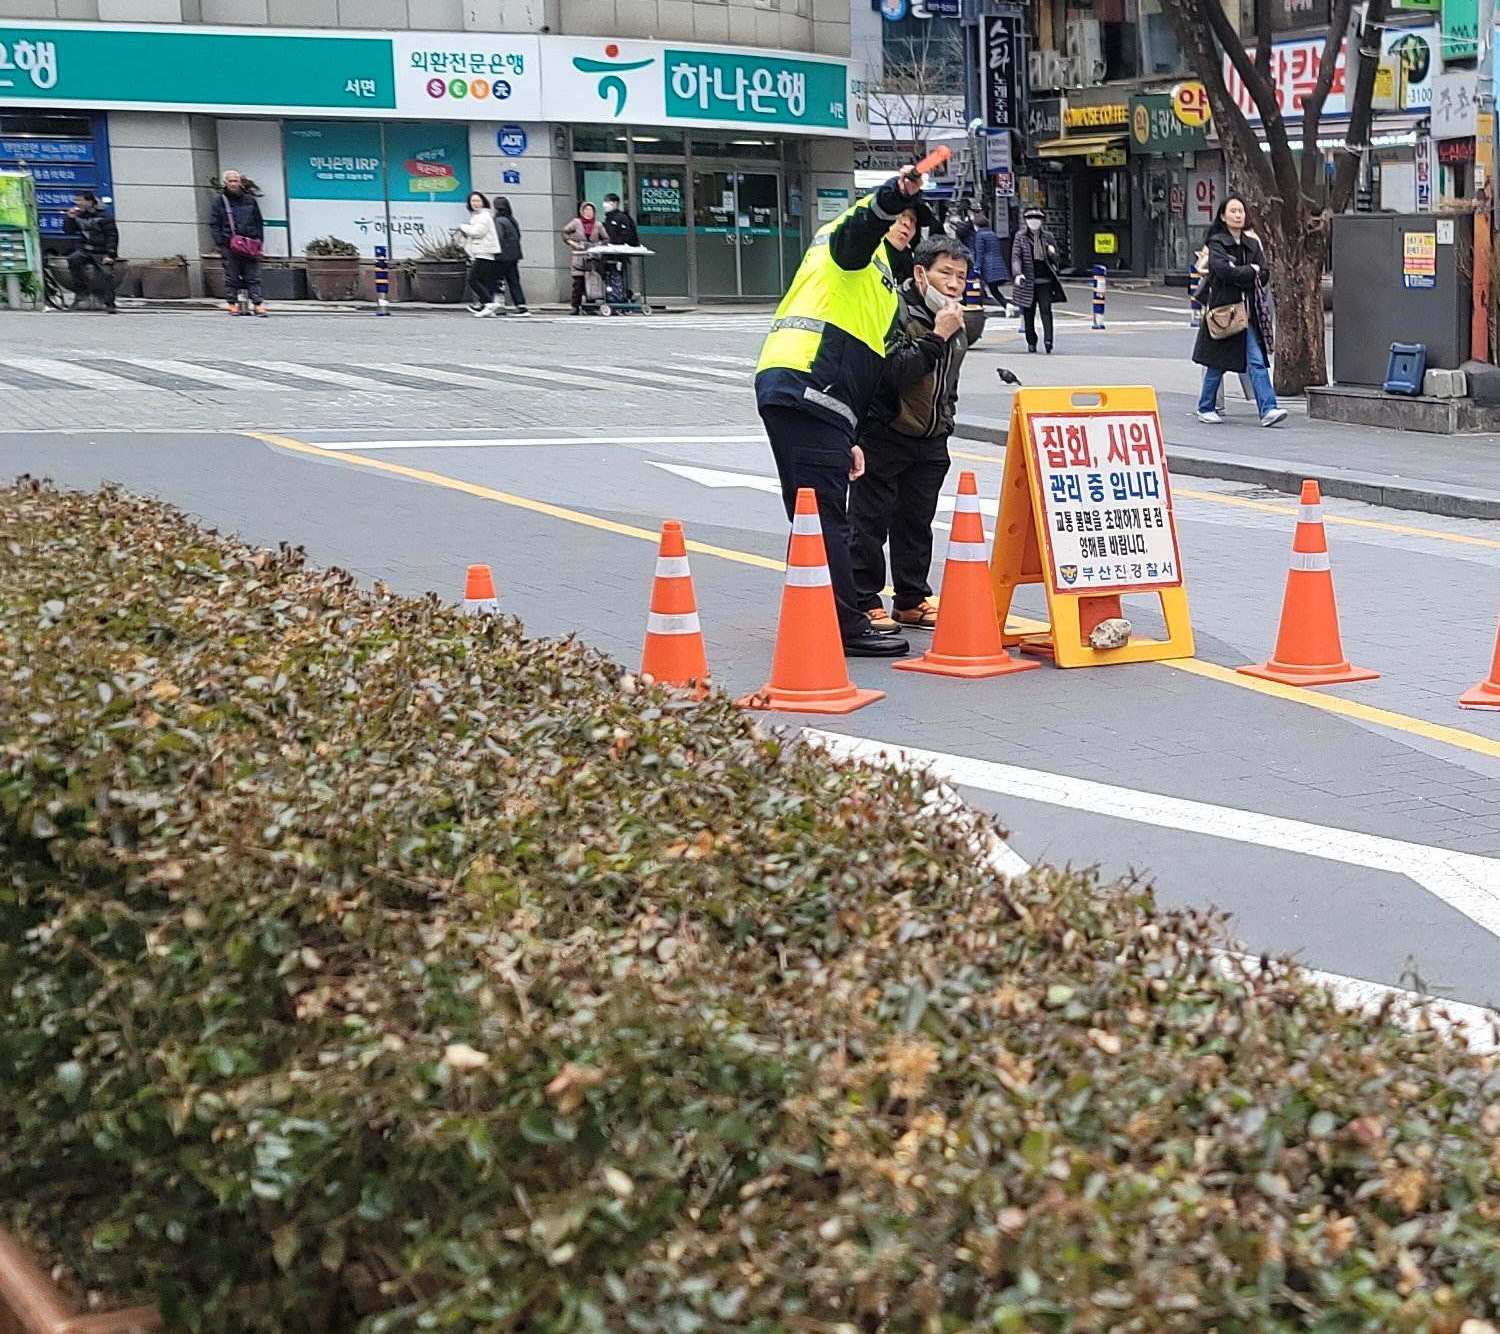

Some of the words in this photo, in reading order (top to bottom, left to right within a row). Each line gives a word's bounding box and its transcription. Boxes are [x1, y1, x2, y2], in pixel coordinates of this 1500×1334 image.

[410, 50, 525, 75] 외환전문은행
[344, 77, 377, 98] 서면
[671, 62, 806, 118] 하나은행
[829, 102, 844, 119] 서면
[1179, 88, 1208, 122] 약
[502, 134, 523, 148] ADT
[310, 156, 353, 171] 하나은행
[355, 157, 380, 170] IRP
[641, 187, 681, 200] FOREIGN
[1171, 187, 1184, 218] 약
[1196, 178, 1216, 222] 약
[375, 222, 425, 236] 하나은행
[1040, 423, 1099, 469] 집회,
[1107, 422, 1155, 466] 시위
[1050, 473, 1084, 504] 관리
[1088, 472, 1105, 503] 중
[1109, 470, 1160, 501] 입니다
[1105, 507, 1142, 531] 초래하게
[1143, 506, 1154, 529] 된
[1154, 505, 1164, 528] 점
[1079, 535, 1106, 559] 양해를
[1108, 533, 1149, 556] 바랍니다.
